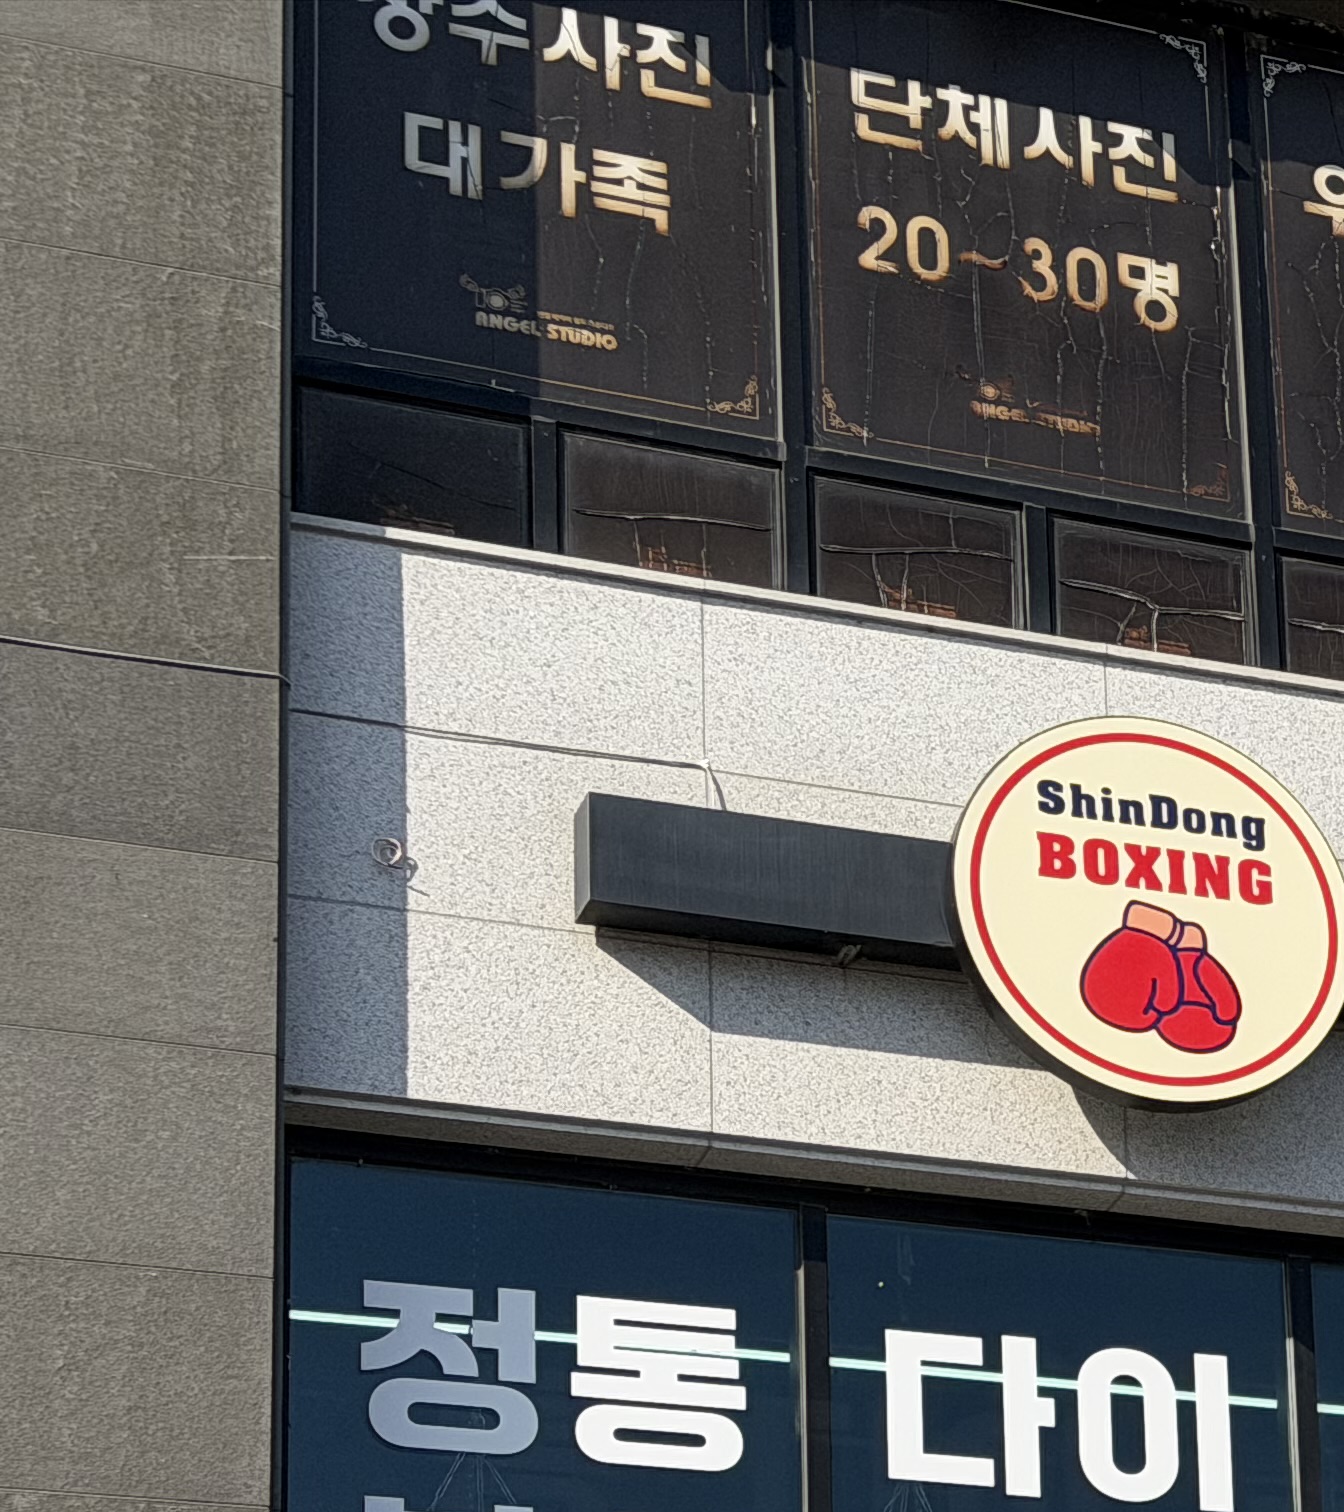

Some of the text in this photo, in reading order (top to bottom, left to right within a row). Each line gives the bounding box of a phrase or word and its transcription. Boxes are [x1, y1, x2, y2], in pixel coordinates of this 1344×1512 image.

[475, 311, 542, 337] ANGEL
[546, 323, 619, 350] STUDIO
[1036, 779, 1266, 852] ShinDong
[1035, 831, 1274, 905] BOXING
[360, 1278, 747, 1473] 정통
